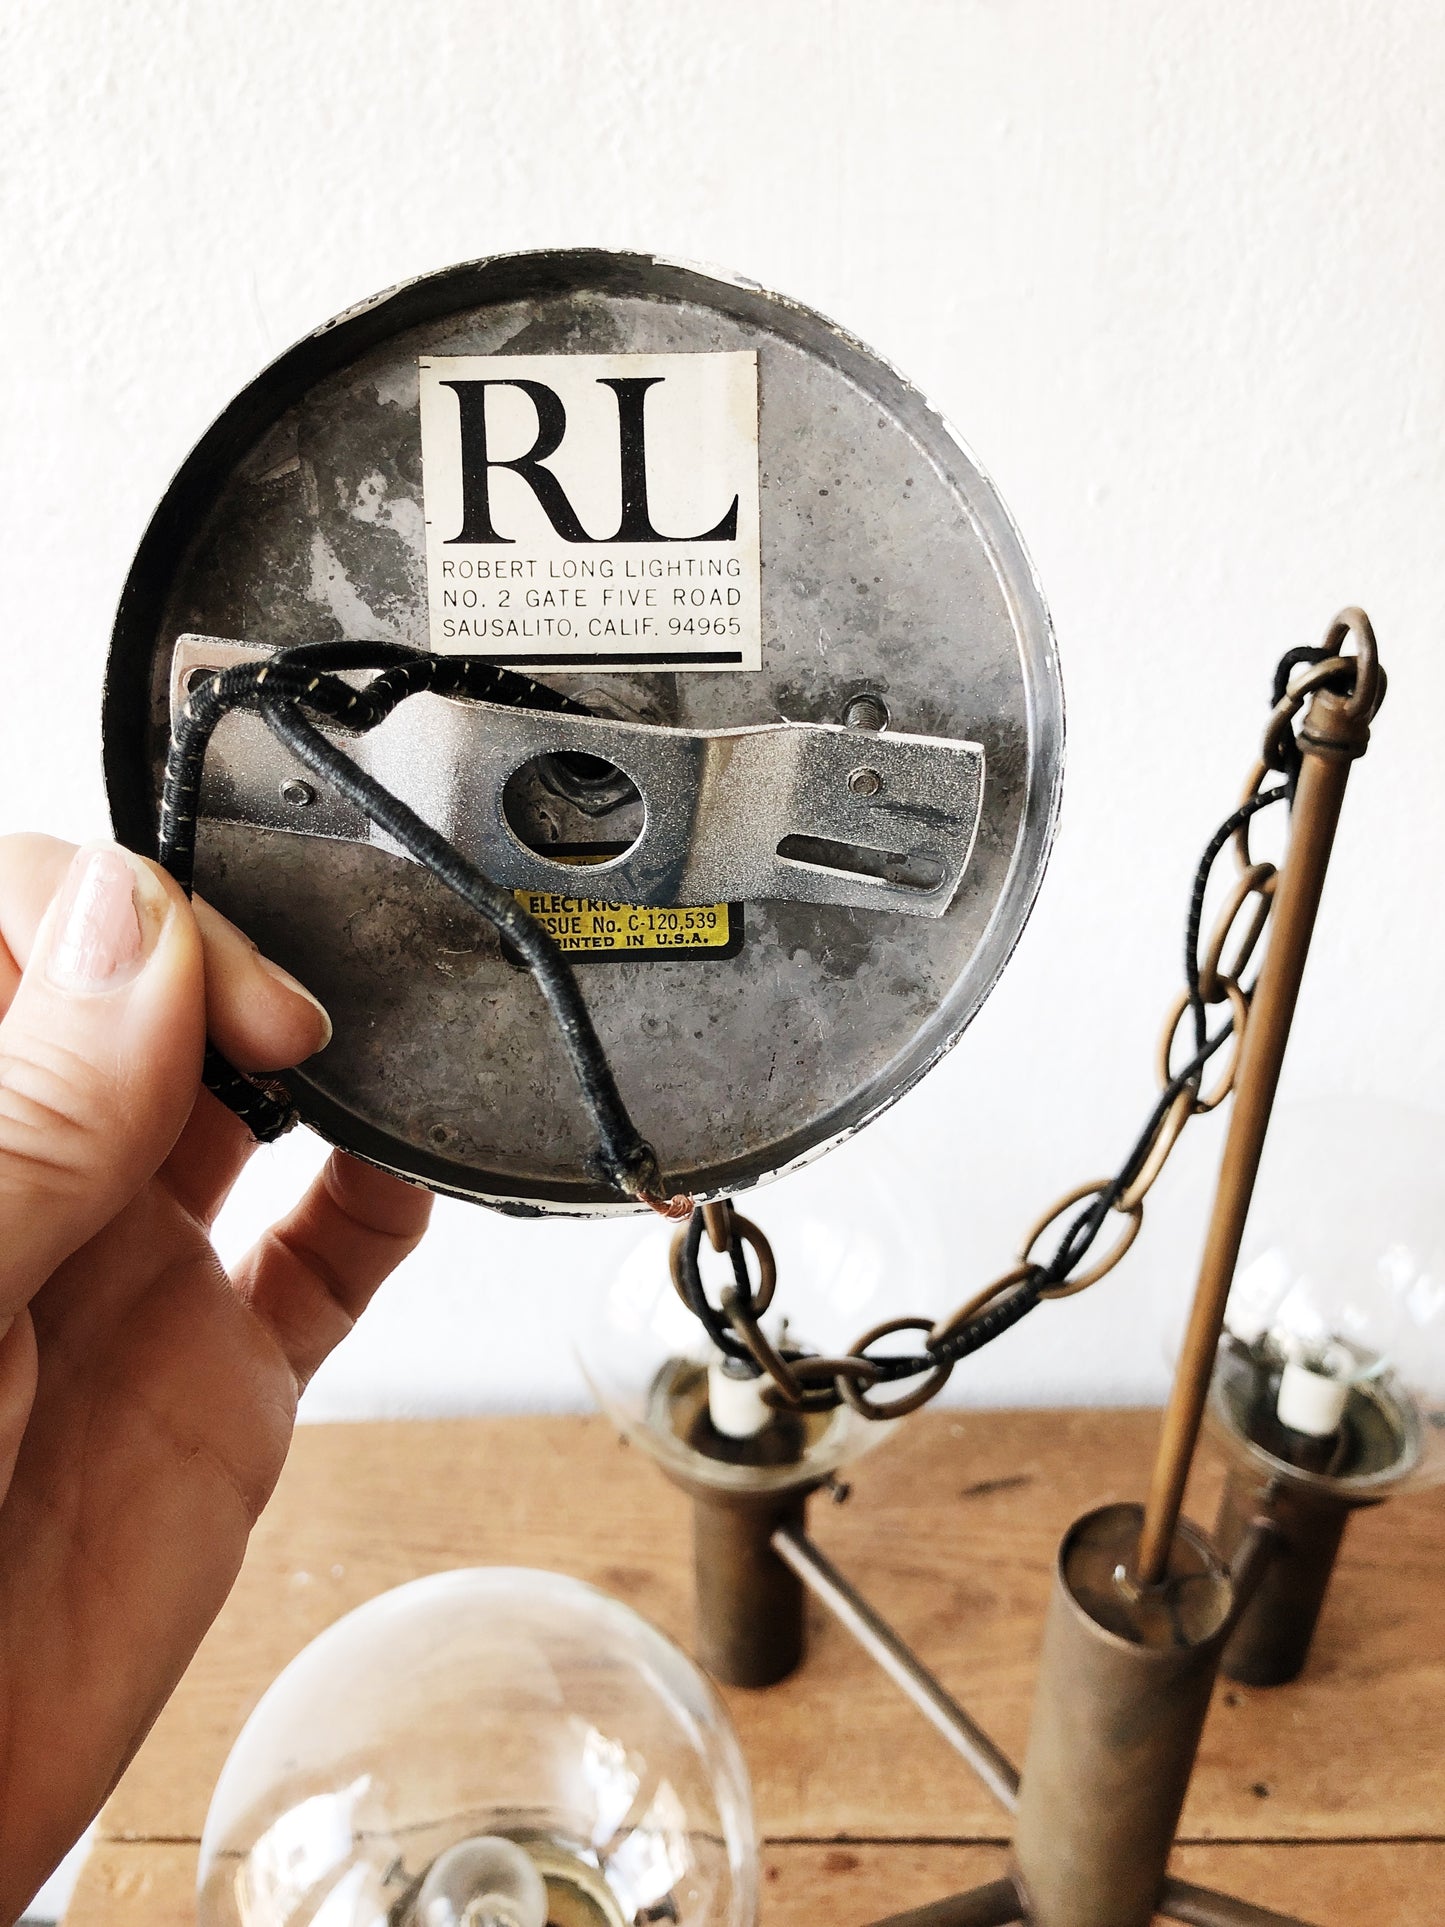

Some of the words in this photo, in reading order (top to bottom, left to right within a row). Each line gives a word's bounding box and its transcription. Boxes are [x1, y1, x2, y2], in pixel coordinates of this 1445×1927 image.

[439, 377, 739, 544] RL
[443, 560, 537, 579] ROBERT
[549, 560, 614, 579] LONG
[625, 559, 741, 578] LIGHTING
[443, 590, 486, 608] NO.
[498, 590, 511, 608] 2
[526, 589, 587, 608] GATE
[603, 588, 657, 607] FIVE
[673, 588, 741, 607] ROAD
[443, 619, 578, 638] SAUSALITO,
[588, 618, 658, 637] CALIF.
[668, 617, 741, 636] 94965
[529, 896, 621, 913] ELECTRIC
[592, 915, 622, 933] No.
[628, 912, 717, 931] C-120,539
[626, 934, 644, 946] IN
[656, 932, 709, 945] U.S.A.
